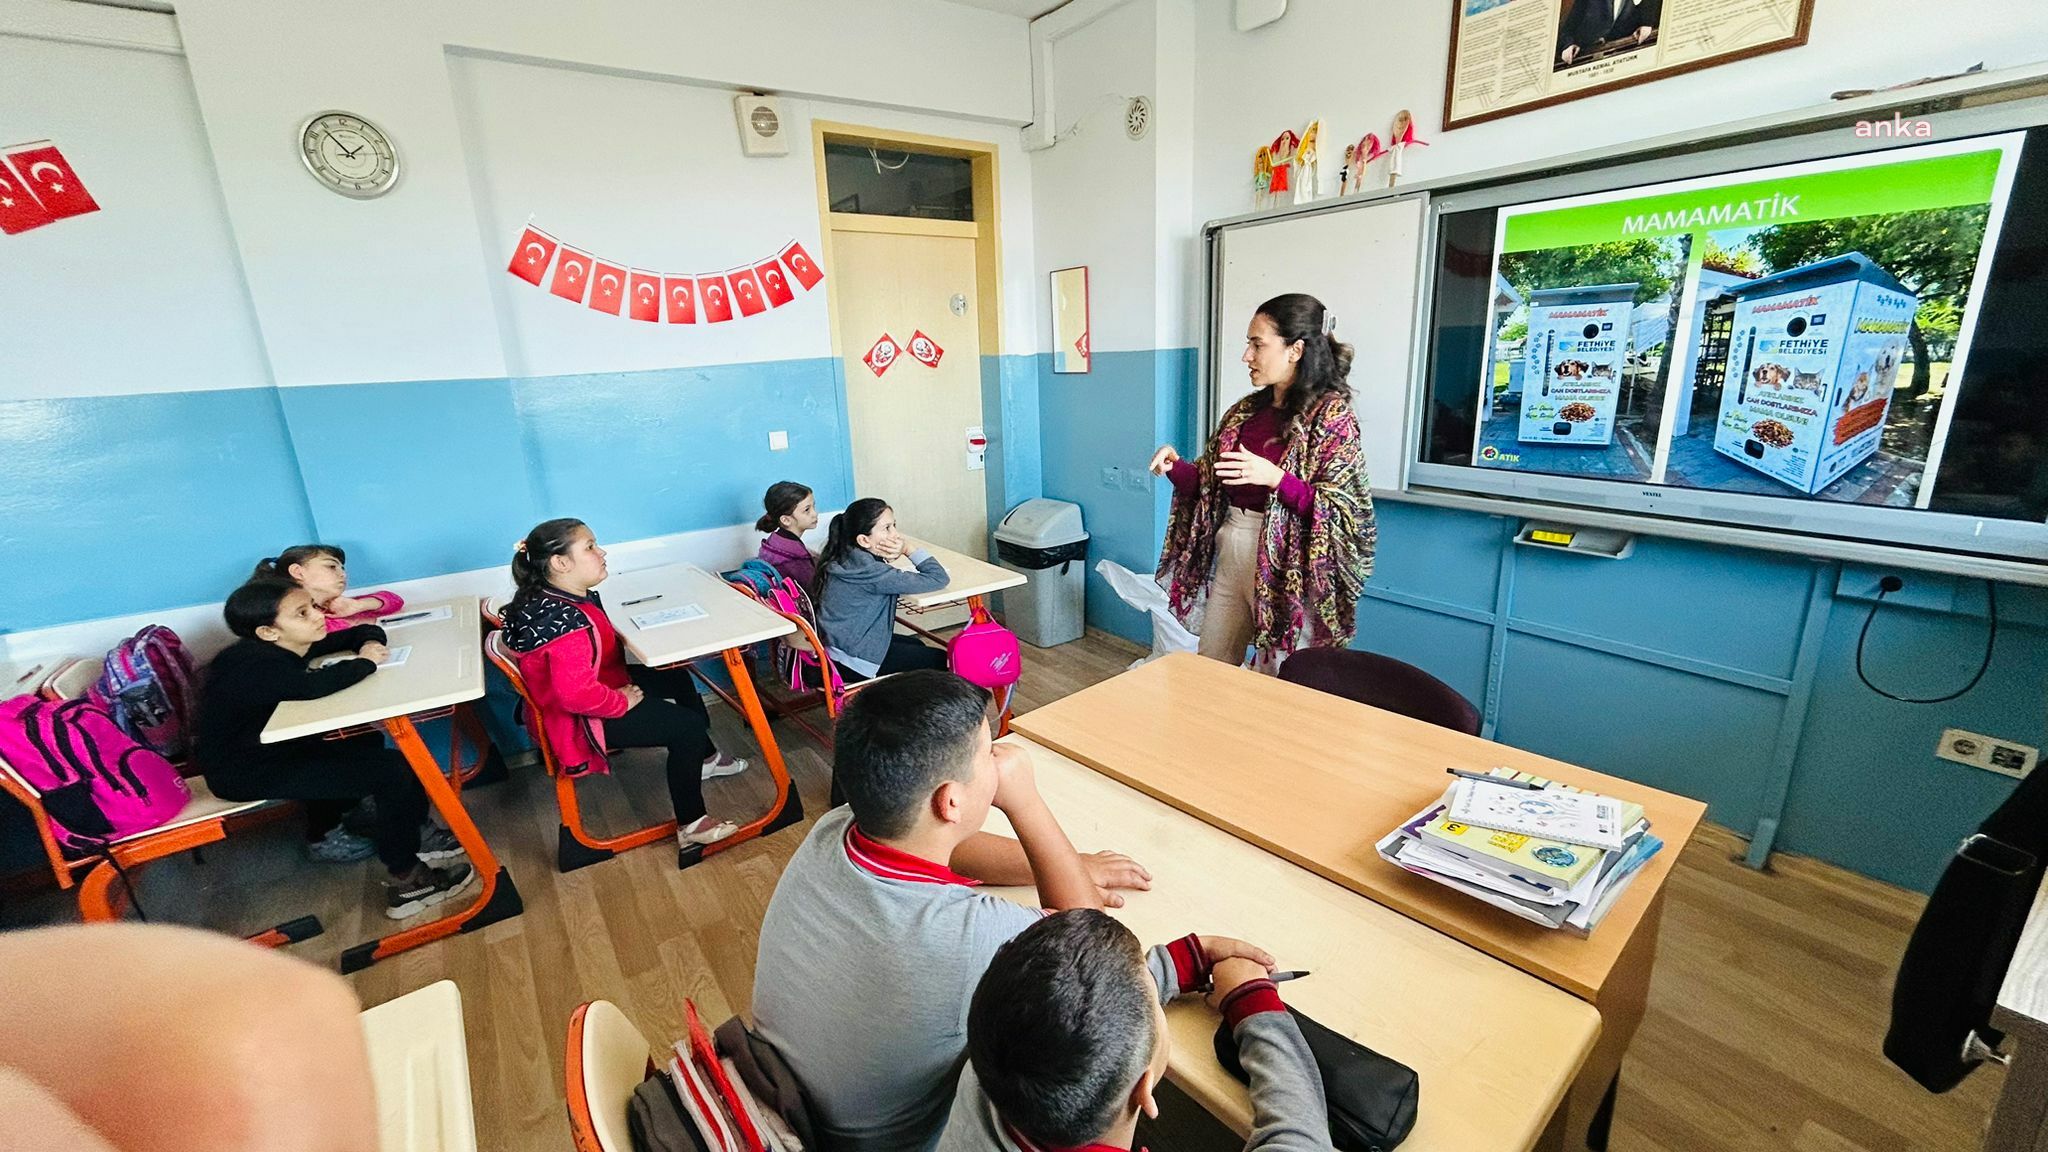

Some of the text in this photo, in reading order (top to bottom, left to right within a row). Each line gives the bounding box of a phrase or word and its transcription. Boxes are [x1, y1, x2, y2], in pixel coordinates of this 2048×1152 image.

[1567, 67, 1591, 77] MUSTAFA
[1622, 192, 1800, 235] MAMAMATİK
[1498, 453, 1520, 463] ATIK
